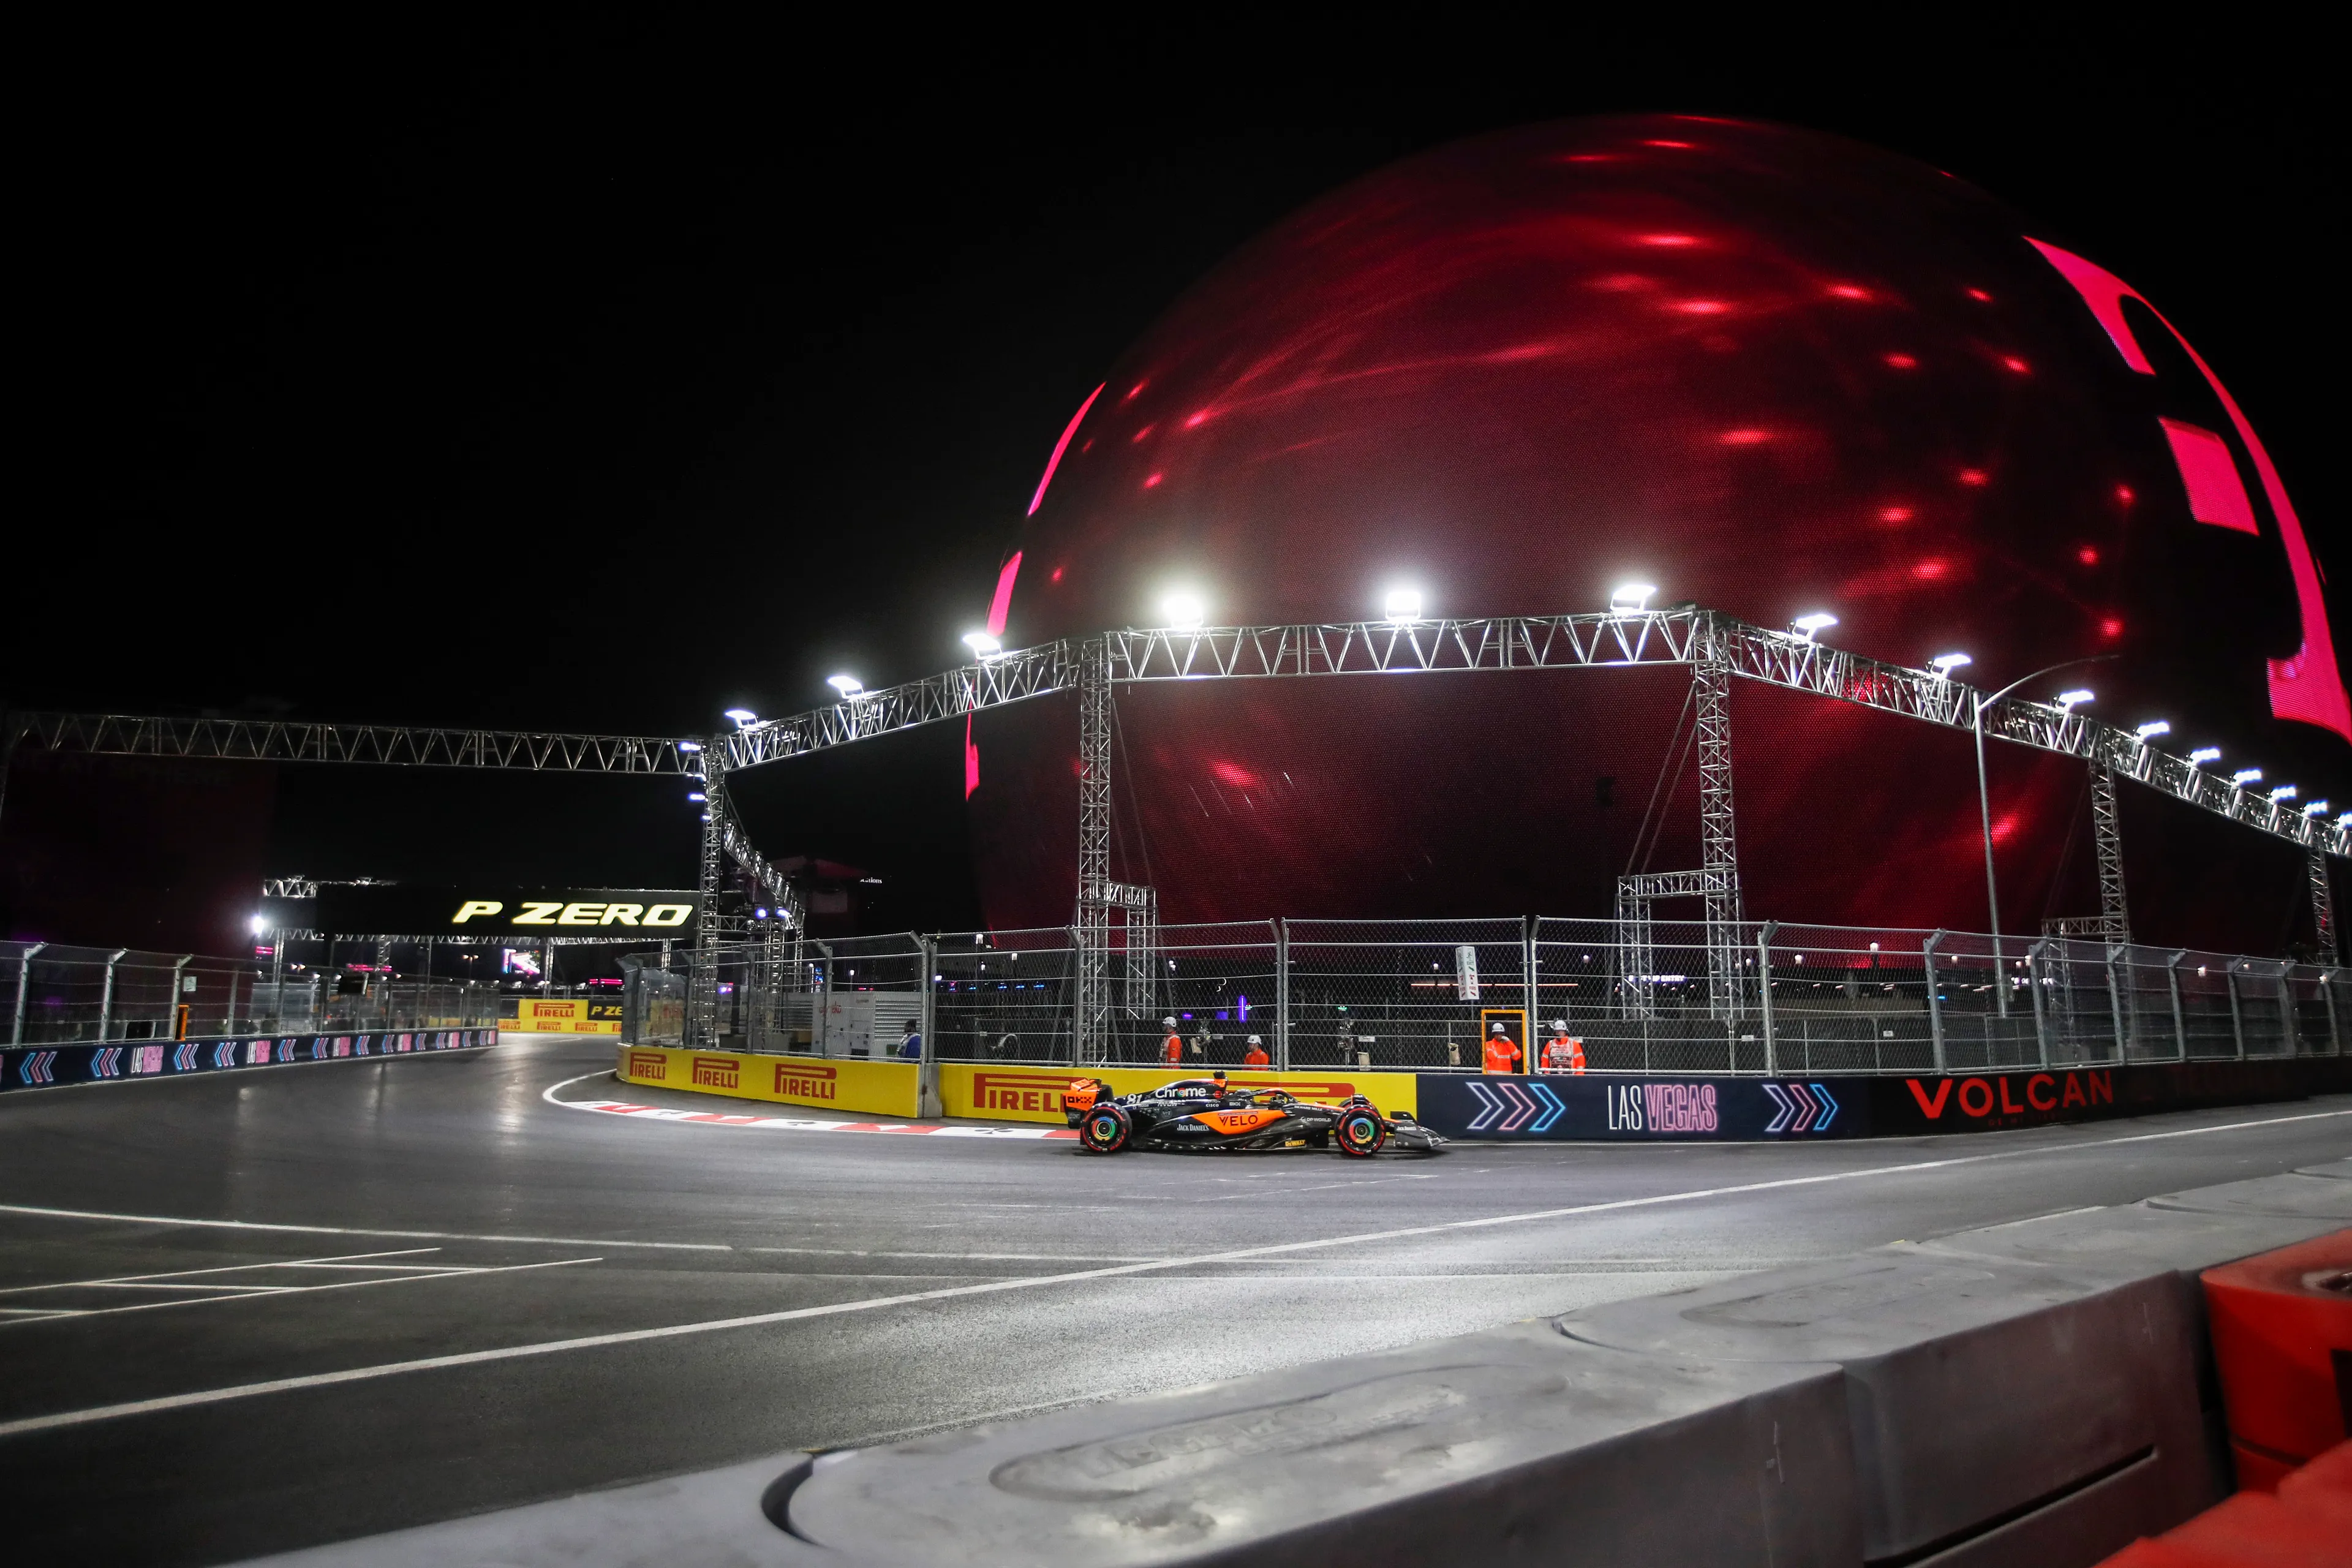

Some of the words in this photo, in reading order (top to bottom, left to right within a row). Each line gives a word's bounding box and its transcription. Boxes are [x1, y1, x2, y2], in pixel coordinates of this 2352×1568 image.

[452, 901, 503, 924] P
[511, 902, 693, 926] ZERO
[533, 1002, 575, 1017] PIRELLI
[590, 1006, 603, 1016] P
[604, 1006, 623, 1016] ZE
[630, 1052, 667, 1080] PIRELLI
[692, 1057, 740, 1088] PIRELLI
[774, 1063, 837, 1099] PIRELLI
[973, 1073, 1089, 1112] PIREL
[1155, 1087, 1207, 1098] Chrome
[1905, 1069, 2113, 1119] VOLCAN
[1126, 1093, 1143, 1105] 81
[1607, 1085, 1642, 1130] LAS
[1643, 1084, 1717, 1131] VEGAS
[1218, 1114, 1258, 1126] VELO
